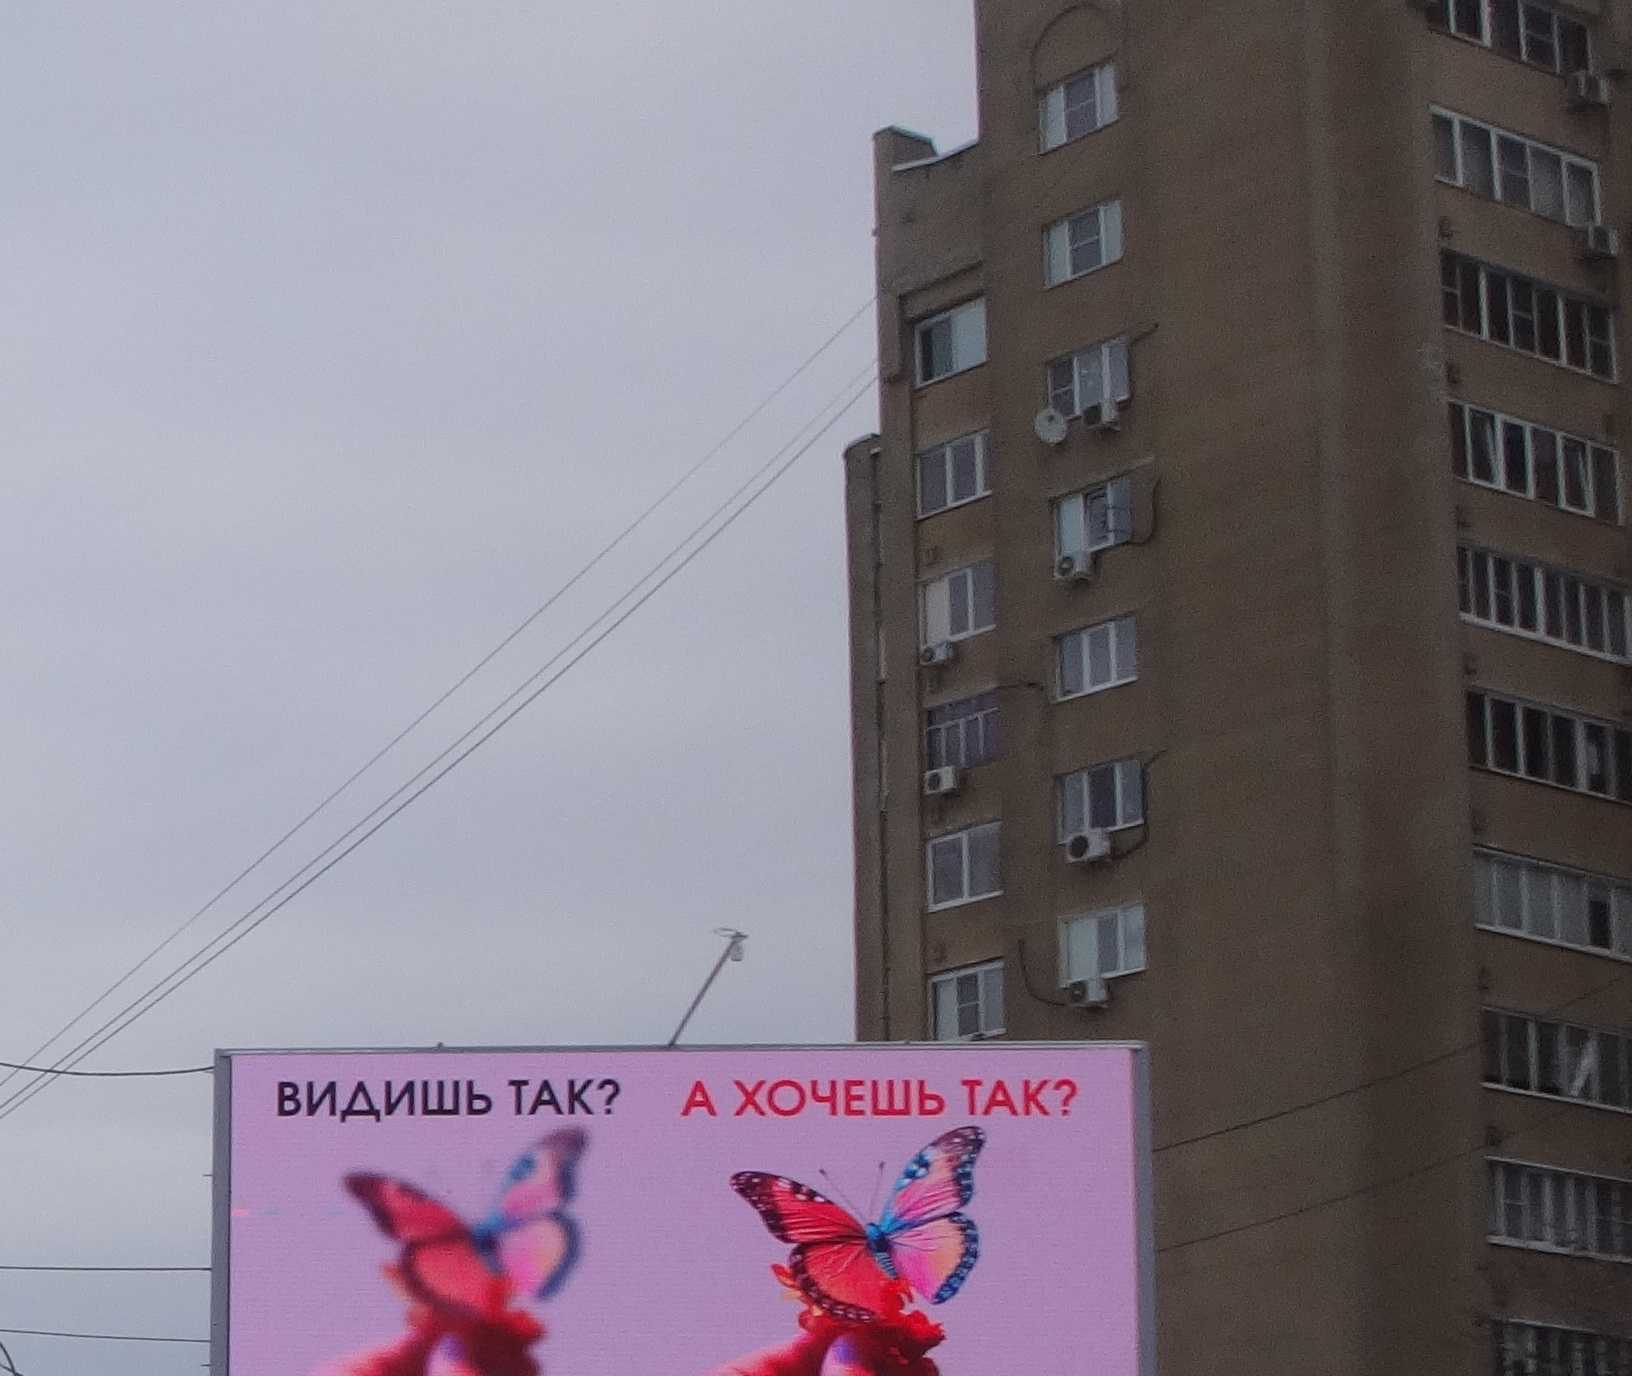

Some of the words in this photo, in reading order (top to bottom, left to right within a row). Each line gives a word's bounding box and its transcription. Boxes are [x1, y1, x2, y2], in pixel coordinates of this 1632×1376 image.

[277, 1080, 493, 1122] ВИДИШЬ
[508, 1079, 621, 1117] ТАК?
[680, 1081, 717, 1117] А
[733, 1080, 945, 1117] ХОЧЕШЬ
[961, 1079, 1078, 1117] ТАК?
